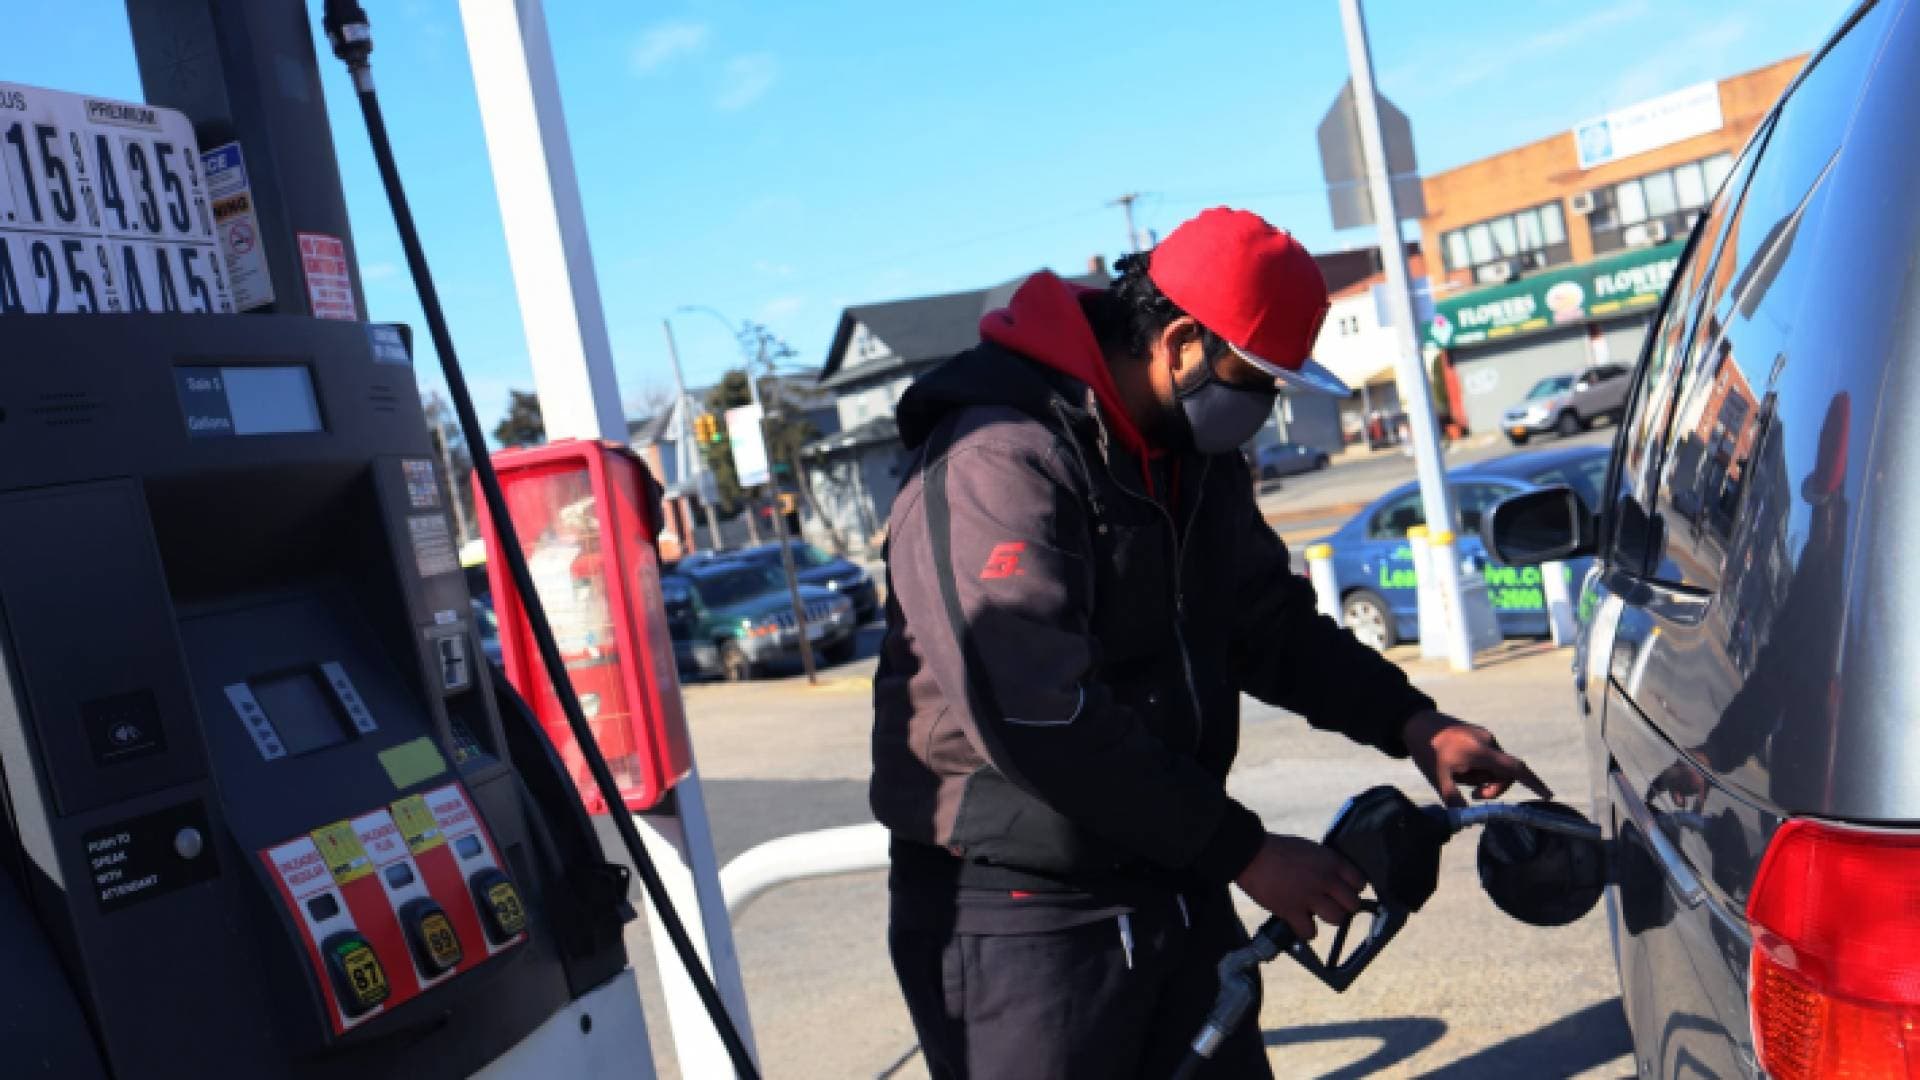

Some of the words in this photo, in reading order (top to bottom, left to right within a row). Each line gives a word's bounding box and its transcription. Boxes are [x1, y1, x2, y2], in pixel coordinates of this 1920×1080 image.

[88, 103, 158, 123] PREMIUM
[94, 134, 160, 232] 4.35
[1456, 294, 1536, 329] FLOWERS
[352, 961, 379, 989] 87
